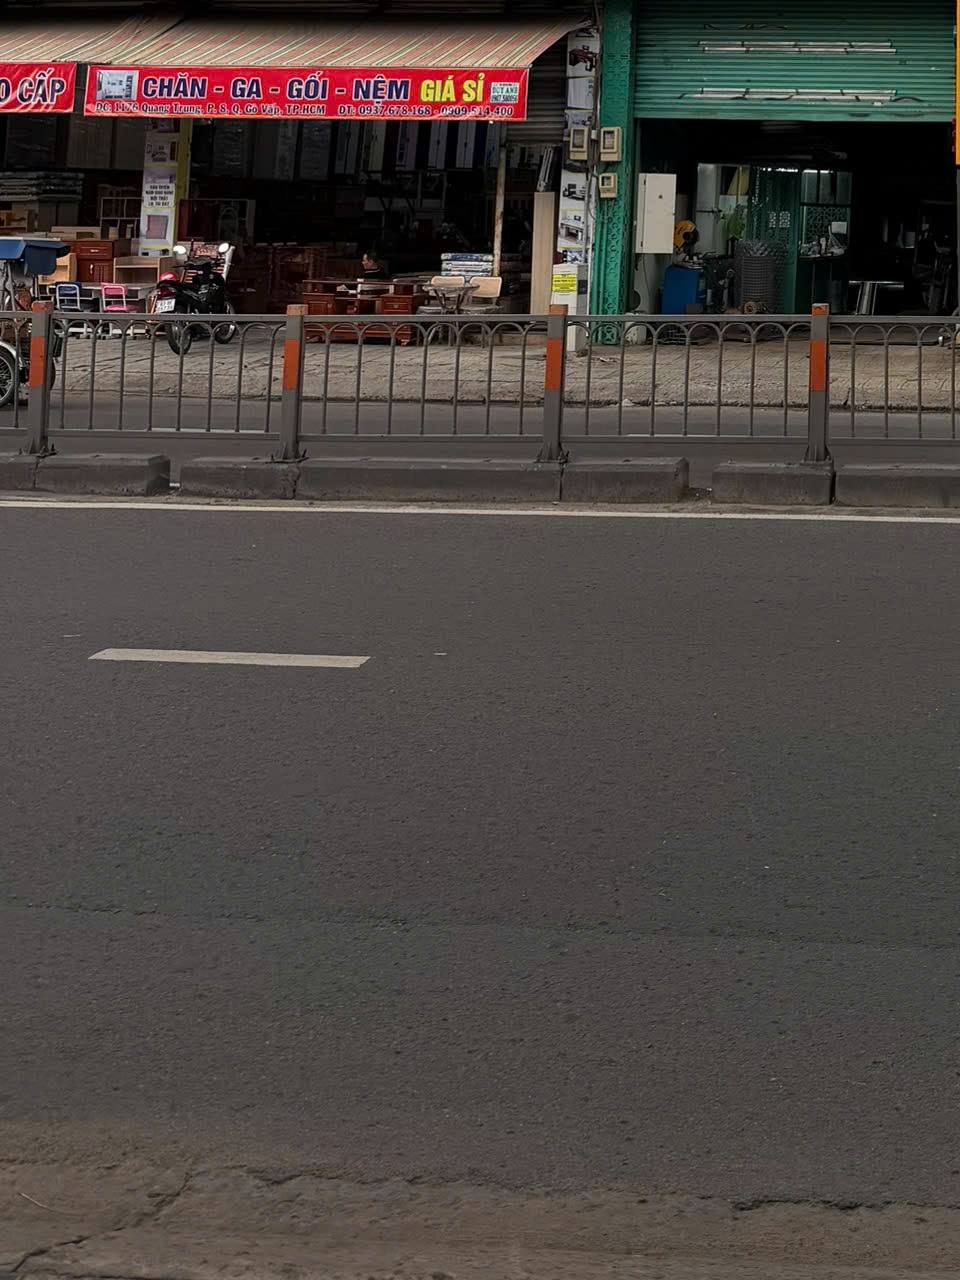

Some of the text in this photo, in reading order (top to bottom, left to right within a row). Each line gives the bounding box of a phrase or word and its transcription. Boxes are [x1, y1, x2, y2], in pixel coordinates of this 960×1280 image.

[17, 68, 66, 104] CẤP
[142, 71, 208, 99] CHĂN
[230, 77, 263, 100] GA
[286, 70, 328, 101] GỐI
[353, 74, 410, 104] NỆM
[420, 75, 457, 103] GIÁ
[462, 72, 485, 102] SỈ
[114, 103, 138, 113] 1176
[141, 103, 169, 114] Quang
[207, 104, 217, 113] P.
[232, 104, 243, 114] Q.
[286, 104, 326, 115] TP.HCM
[338, 105, 356, 115] ĐT:
[359, 105, 431, 116] 0937.678.168
[440, 106, 514, 117] 0909.514.400
